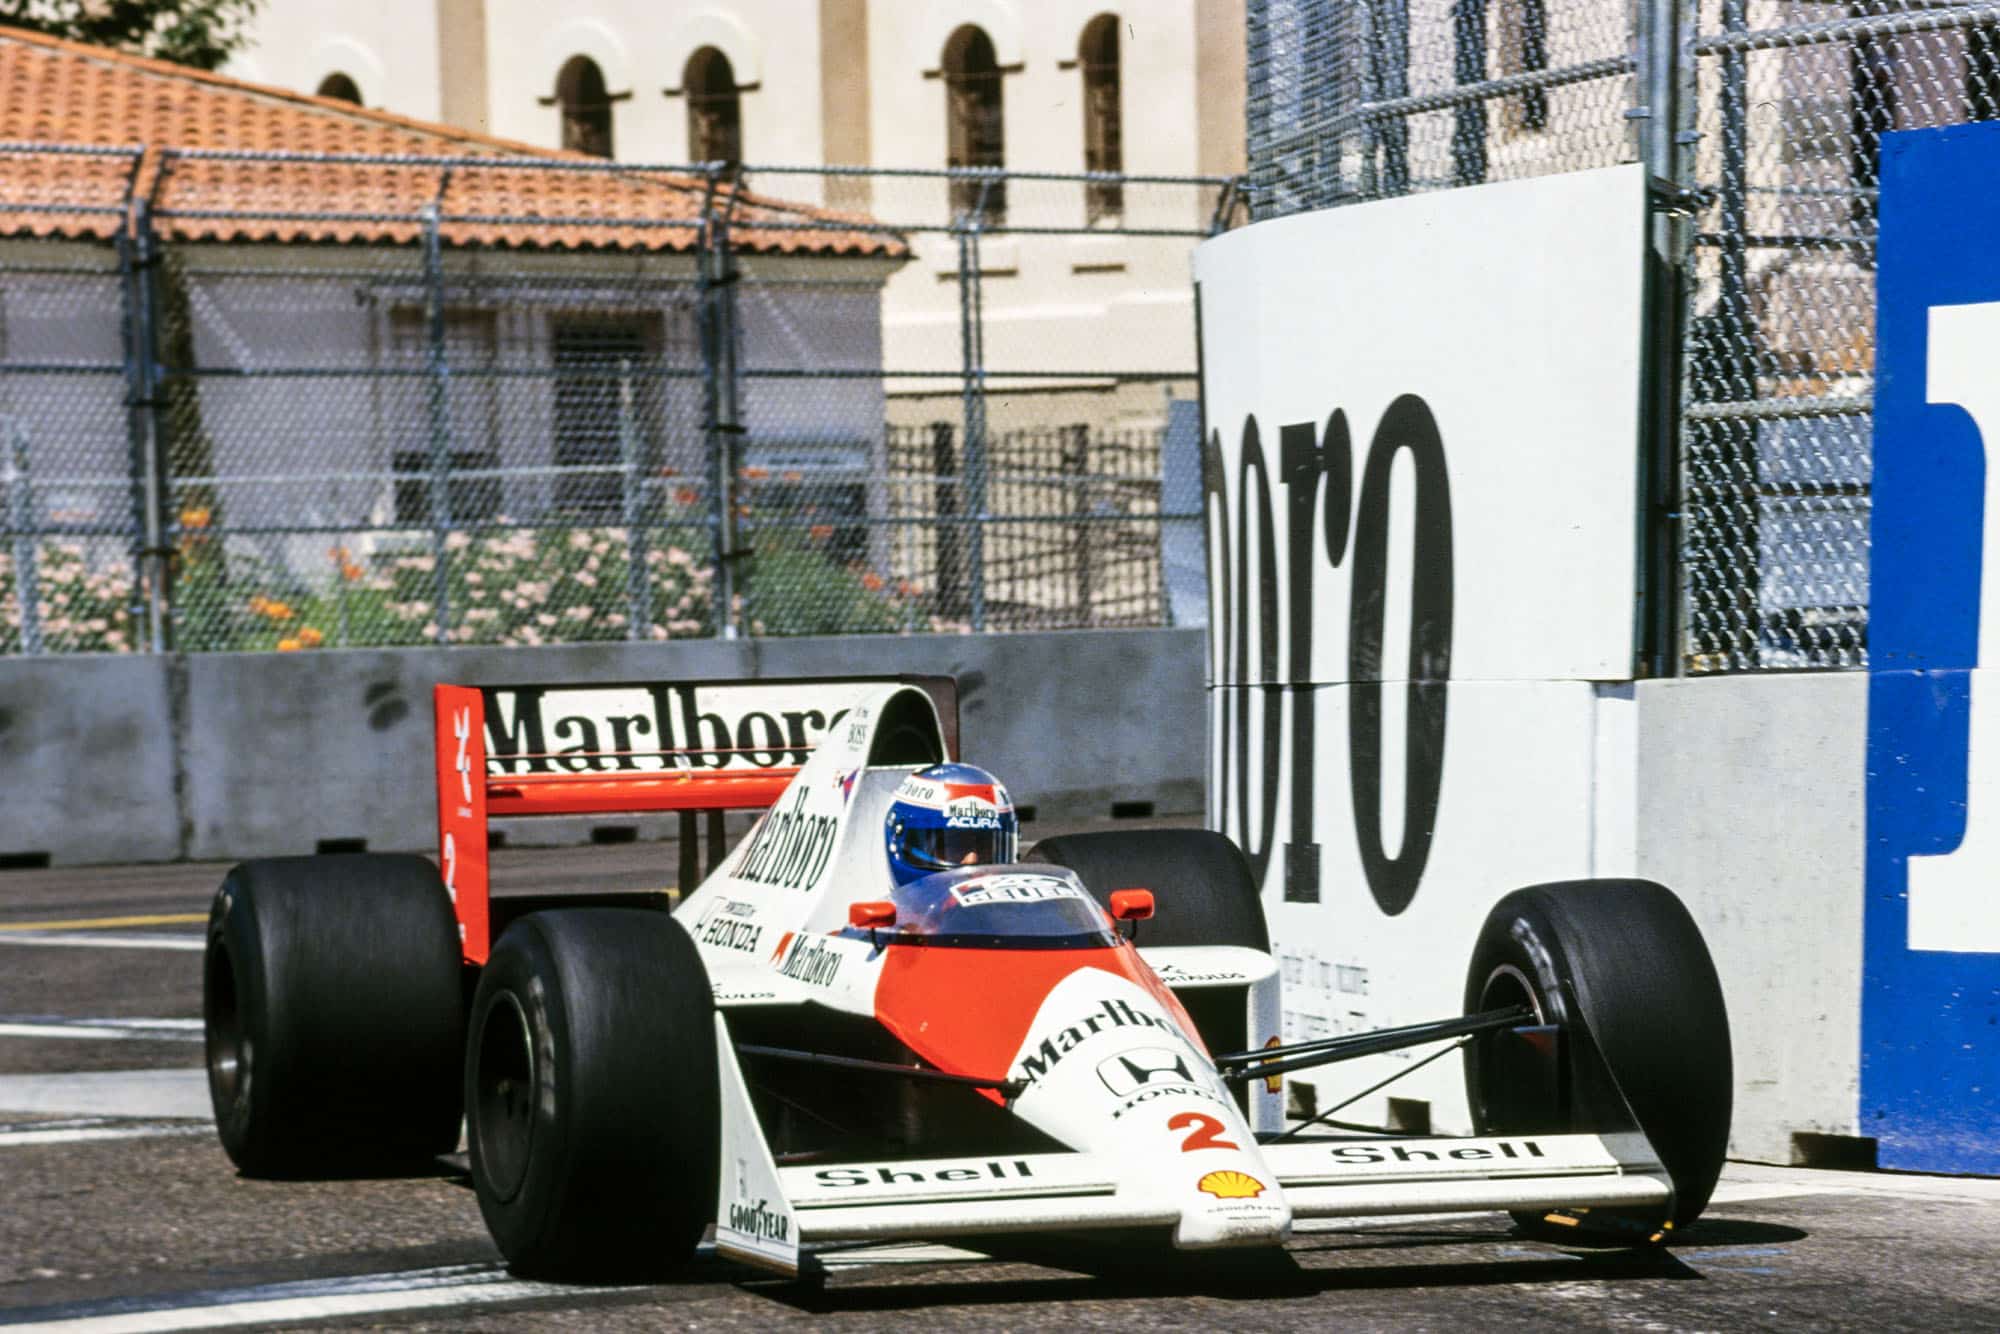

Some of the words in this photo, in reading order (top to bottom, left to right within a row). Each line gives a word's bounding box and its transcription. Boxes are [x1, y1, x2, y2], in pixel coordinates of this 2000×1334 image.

[484, 687, 851, 775] Marlbor
[946, 816, 1002, 829] ACURA
[949, 800, 997, 817] Marlboro
[702, 917, 763, 953] HONDA
[782, 933, 843, 988] Marlboro
[1167, 1111, 1240, 1152] 2
[1331, 1141, 1545, 1165] Shell
[815, 1160, 1034, 1187] Shell
